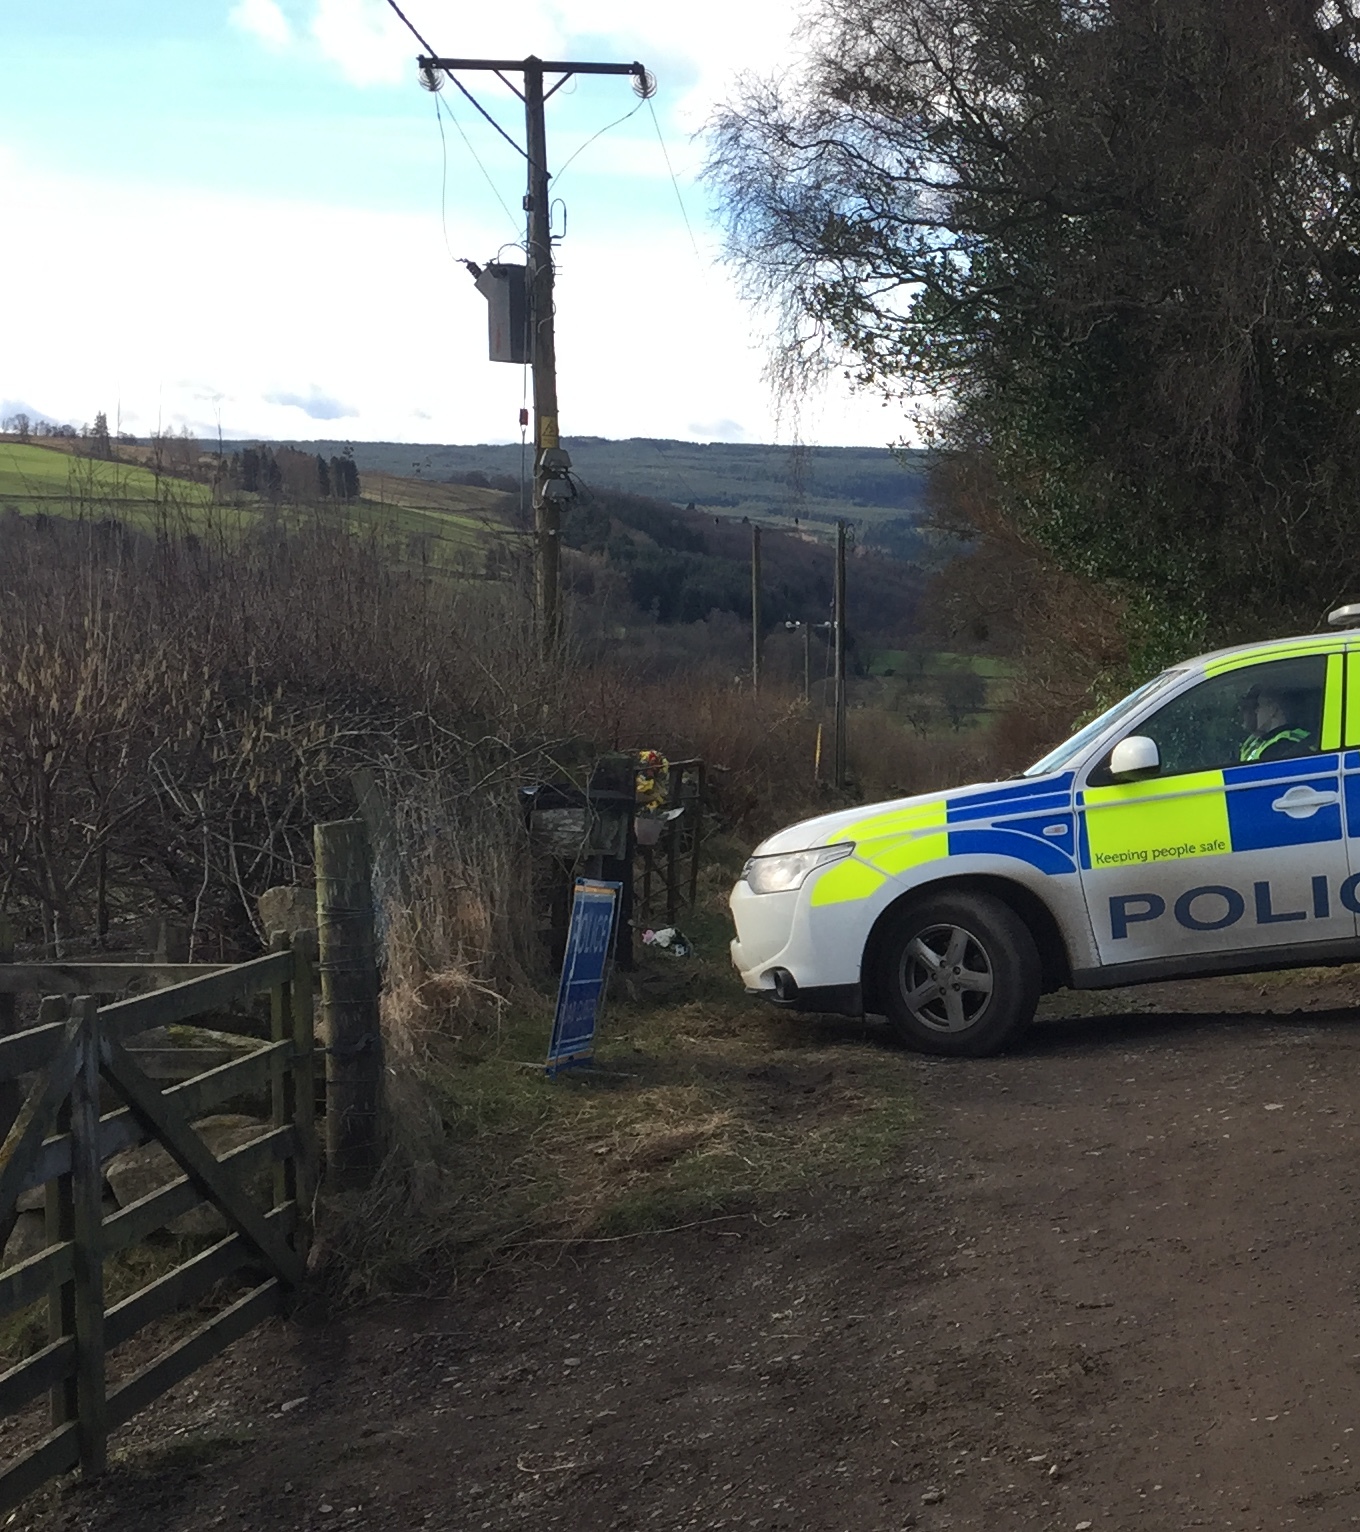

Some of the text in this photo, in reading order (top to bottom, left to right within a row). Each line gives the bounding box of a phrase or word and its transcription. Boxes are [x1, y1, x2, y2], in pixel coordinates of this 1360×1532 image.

[1095, 840, 1226, 865] Keeping people safe
